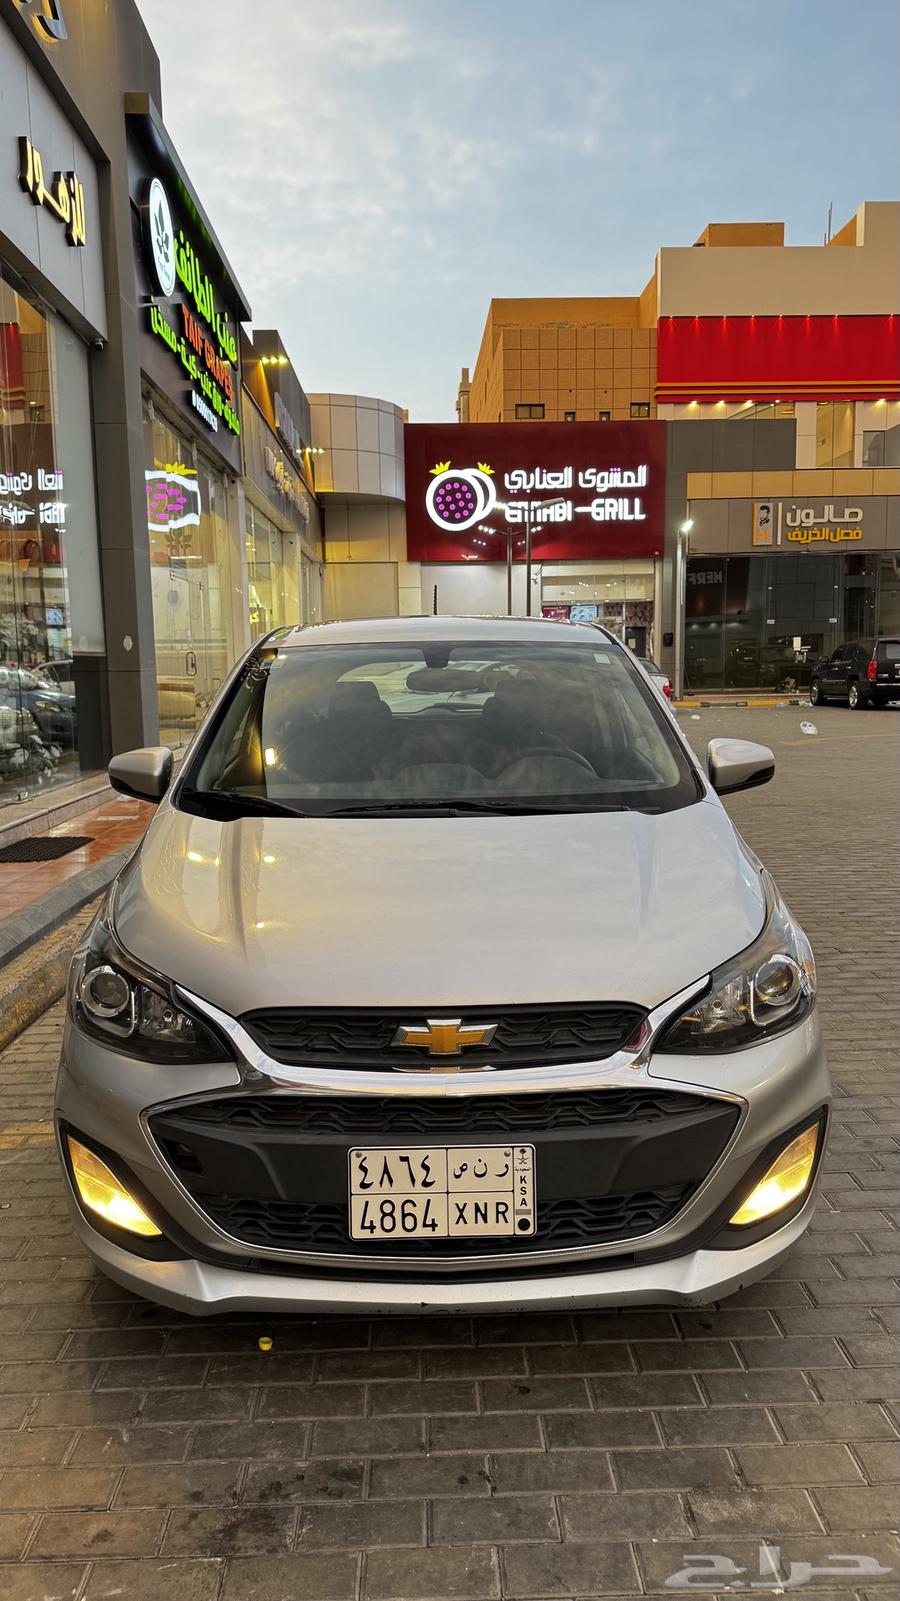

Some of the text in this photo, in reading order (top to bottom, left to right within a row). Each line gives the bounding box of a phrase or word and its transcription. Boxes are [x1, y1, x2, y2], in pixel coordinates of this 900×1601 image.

[182, 303, 203, 356] TAIF
[216, 311, 238, 363] عنب
[504, 466, 573, 494] العنابي
[786, 504, 864, 527] صالون
[787, 526, 863, 544] فصل الخريف
[358, 1154, 436, 1189] ٤٨٦٤
[360, 1199, 438, 1234] 4864
